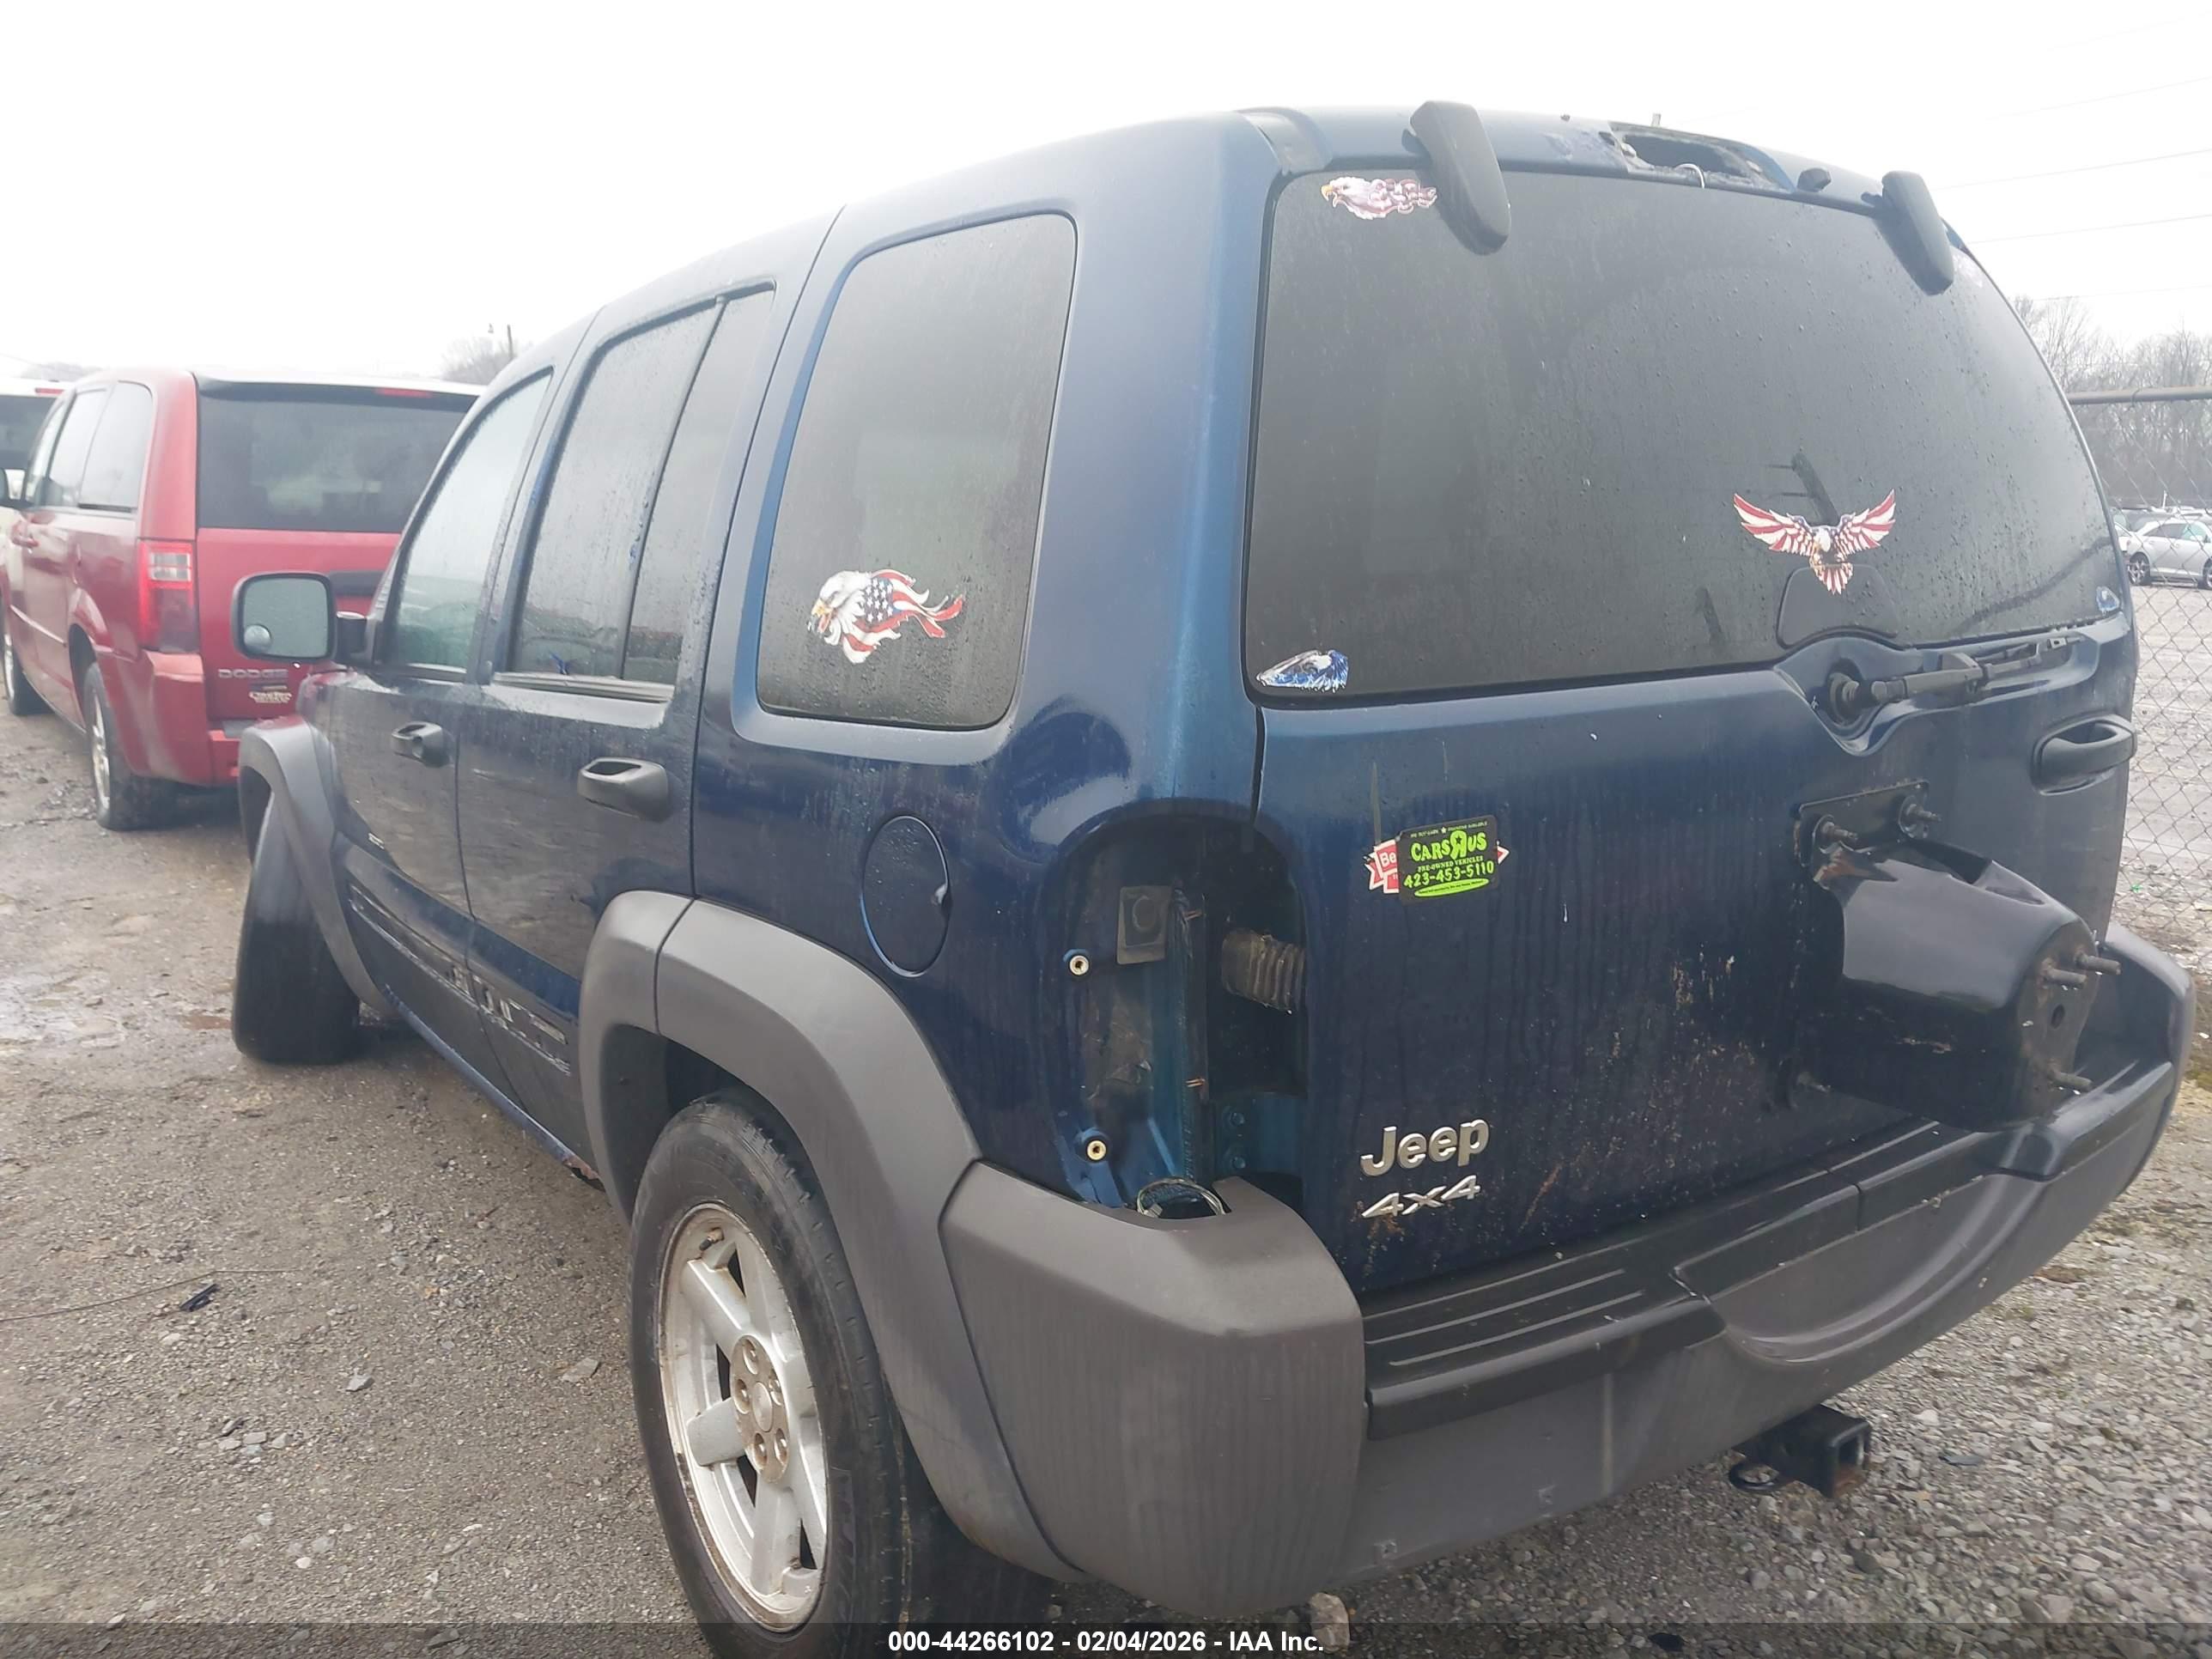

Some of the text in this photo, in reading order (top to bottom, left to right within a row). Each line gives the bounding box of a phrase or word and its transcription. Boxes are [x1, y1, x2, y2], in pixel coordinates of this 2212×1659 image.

[217, 668, 289, 679] DODGE
[1403, 860, 1495, 889] 423-453-5110
[1359, 1119, 1490, 1177] Jeep
